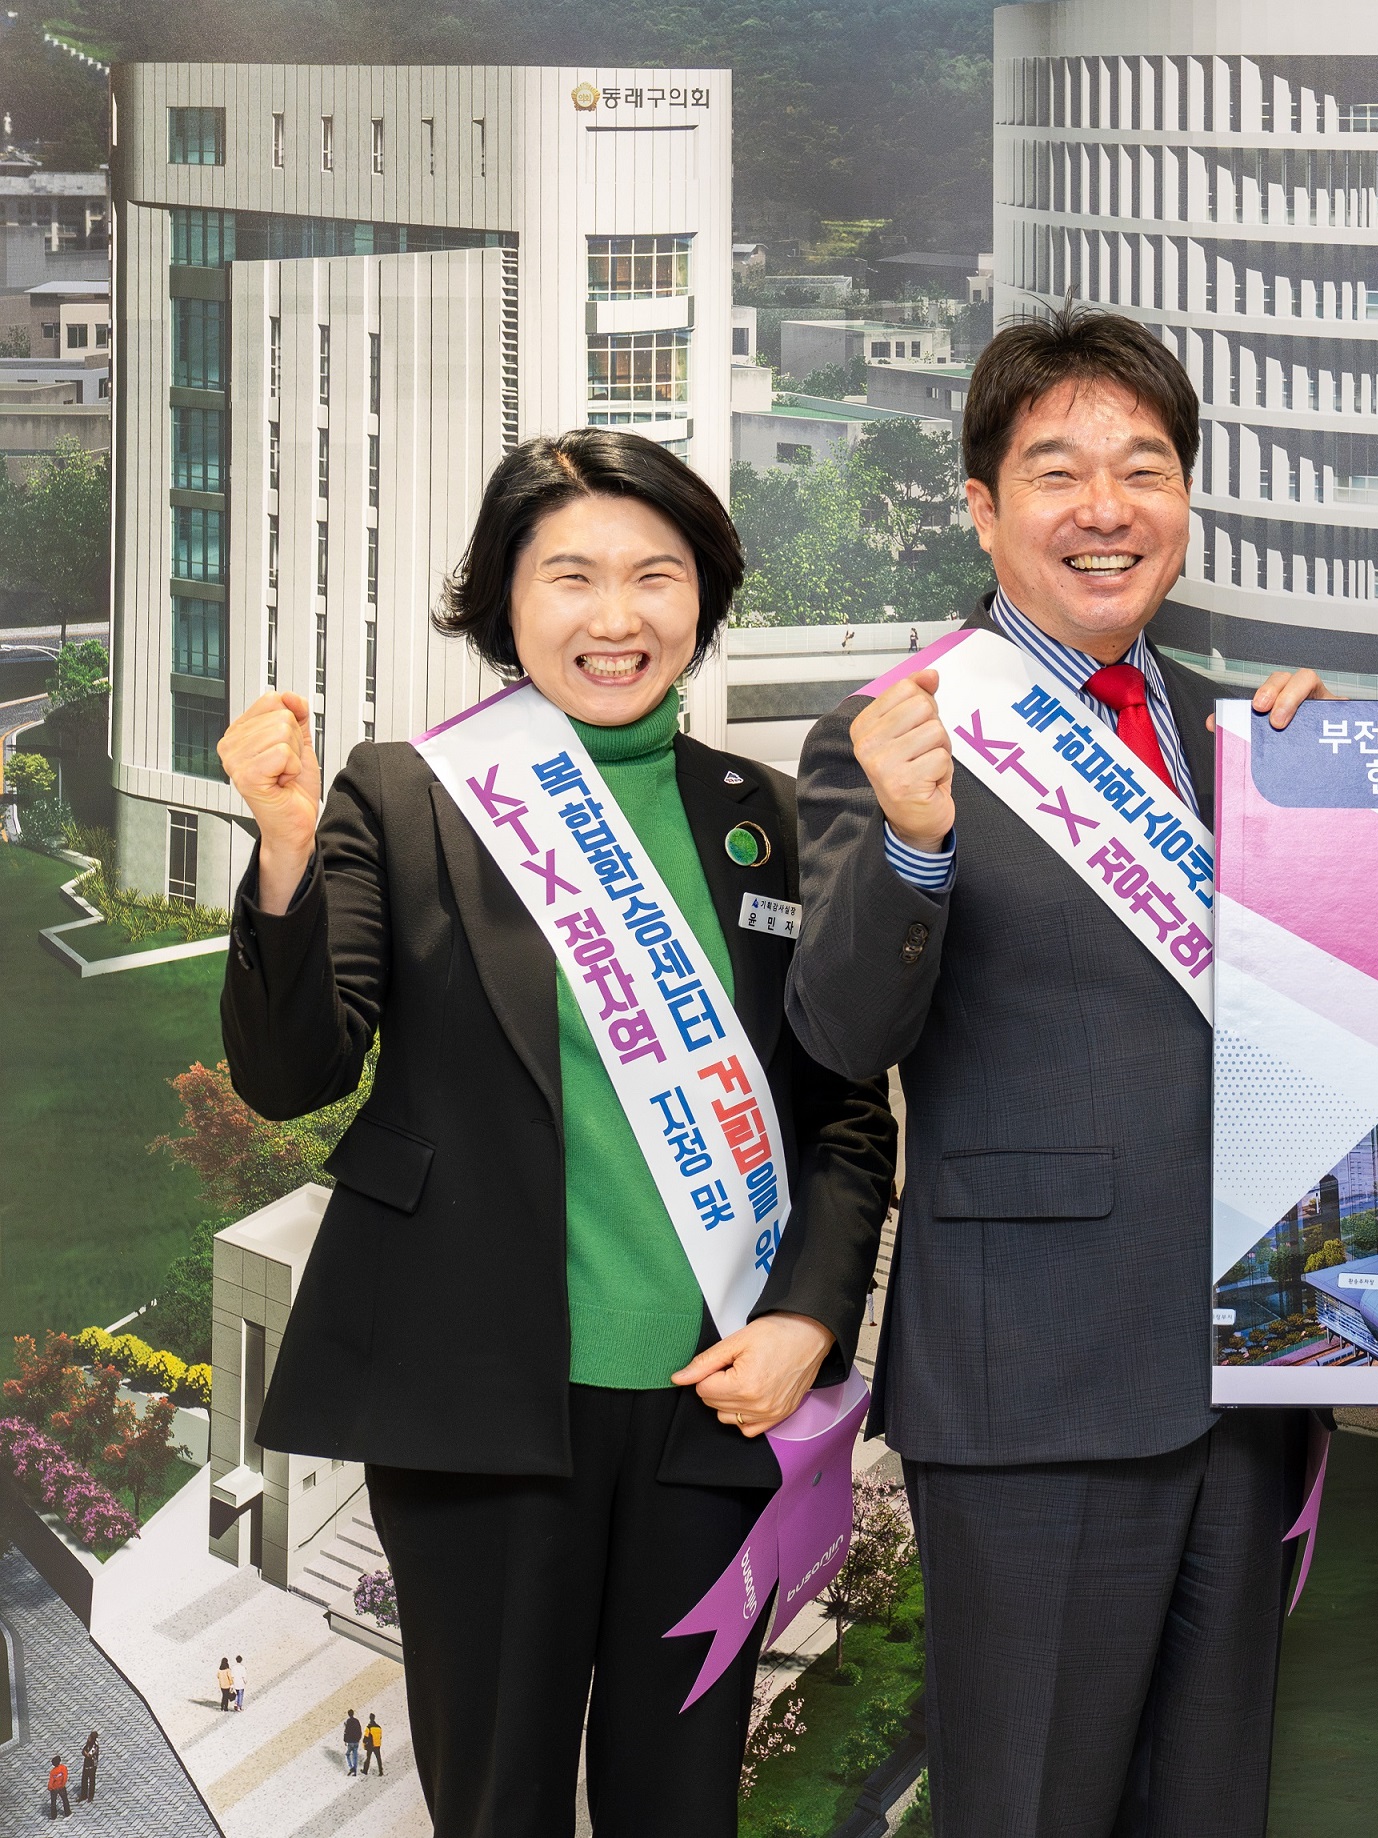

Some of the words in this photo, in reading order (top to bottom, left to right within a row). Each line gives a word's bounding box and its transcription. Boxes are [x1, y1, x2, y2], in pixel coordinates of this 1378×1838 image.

[602, 88, 709, 109] 동래구의회
[760, 900, 796, 916] 기획감사실장
[953, 708, 1101, 847] KTX
[1086, 836, 1214, 979] 정차역
[1010, 684, 1214, 914] 복합환승센
[466, 763, 582, 906] KTX
[554, 906, 667, 1065] 정차역
[649, 1085, 712, 1178] 지정
[691, 1178, 736, 1231] 및
[531, 751, 726, 1052] 복합환승센터
[697, 1054, 779, 1224] 건립을
[786, 1534, 844, 1603] busanjin
